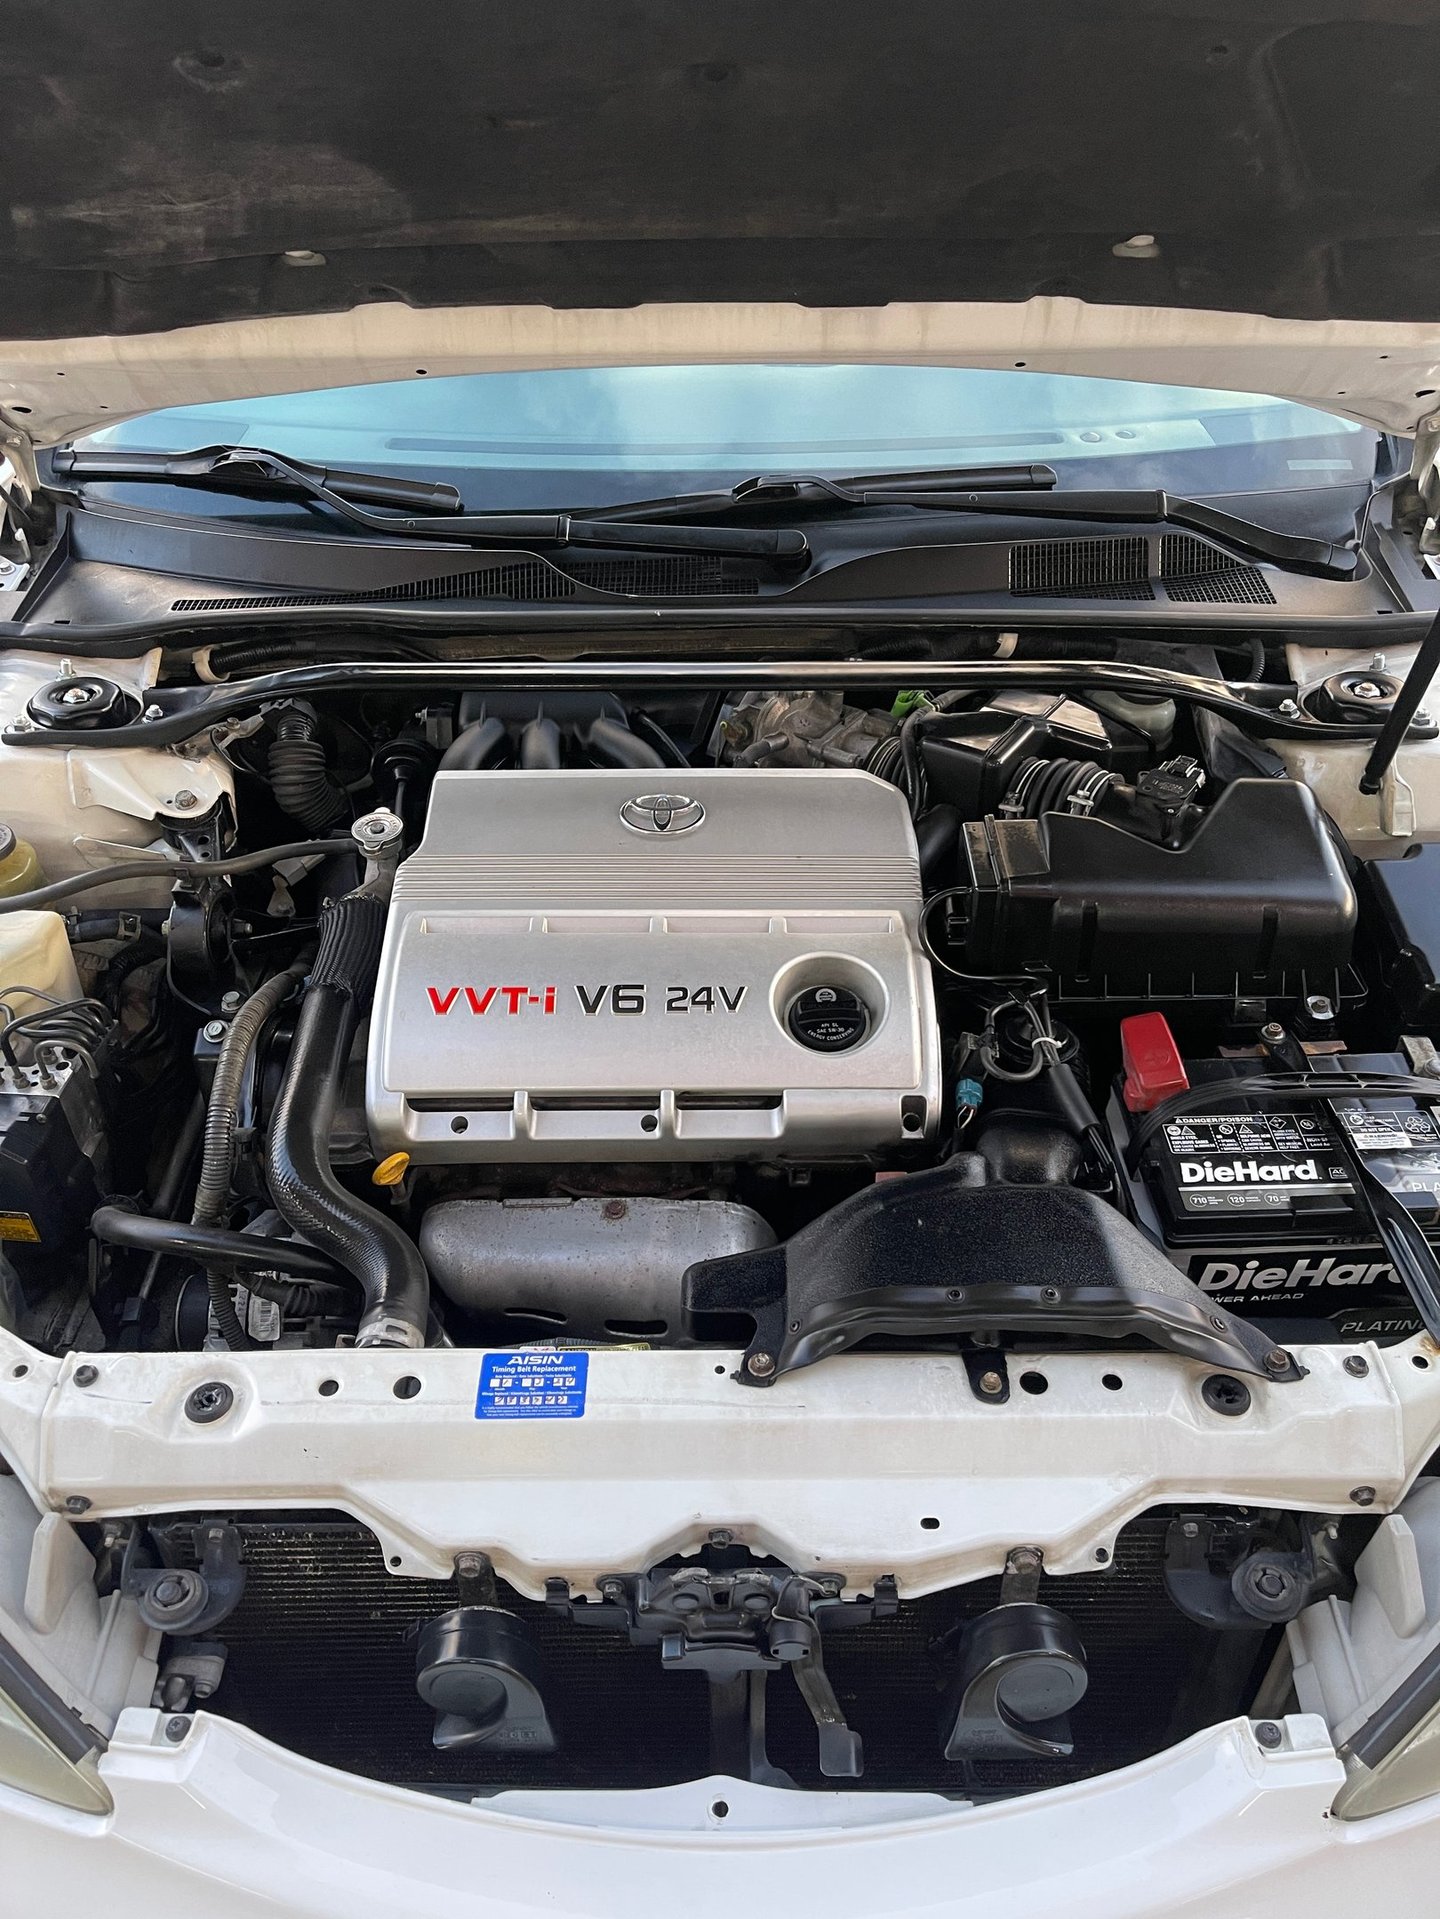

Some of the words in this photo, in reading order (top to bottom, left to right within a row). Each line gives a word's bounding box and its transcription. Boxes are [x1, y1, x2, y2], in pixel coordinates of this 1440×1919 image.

[425, 986, 557, 1015] VVT-i
[574, 984, 646, 1016] V6
[665, 985, 748, 1014] 24V
[1182, 1116, 1253, 1124] DANGER/POISON
[1192, 1196, 1208, 1204] 710
[1229, 1195, 1245, 1203] 120
[1267, 1194, 1279, 1202] 70
[1250, 1293, 1304, 1301] AHEAD
[506, 1355, 564, 1365] AISIN
[492, 1366, 516, 1374] Timing
[532, 1365, 577, 1373] Replacement
